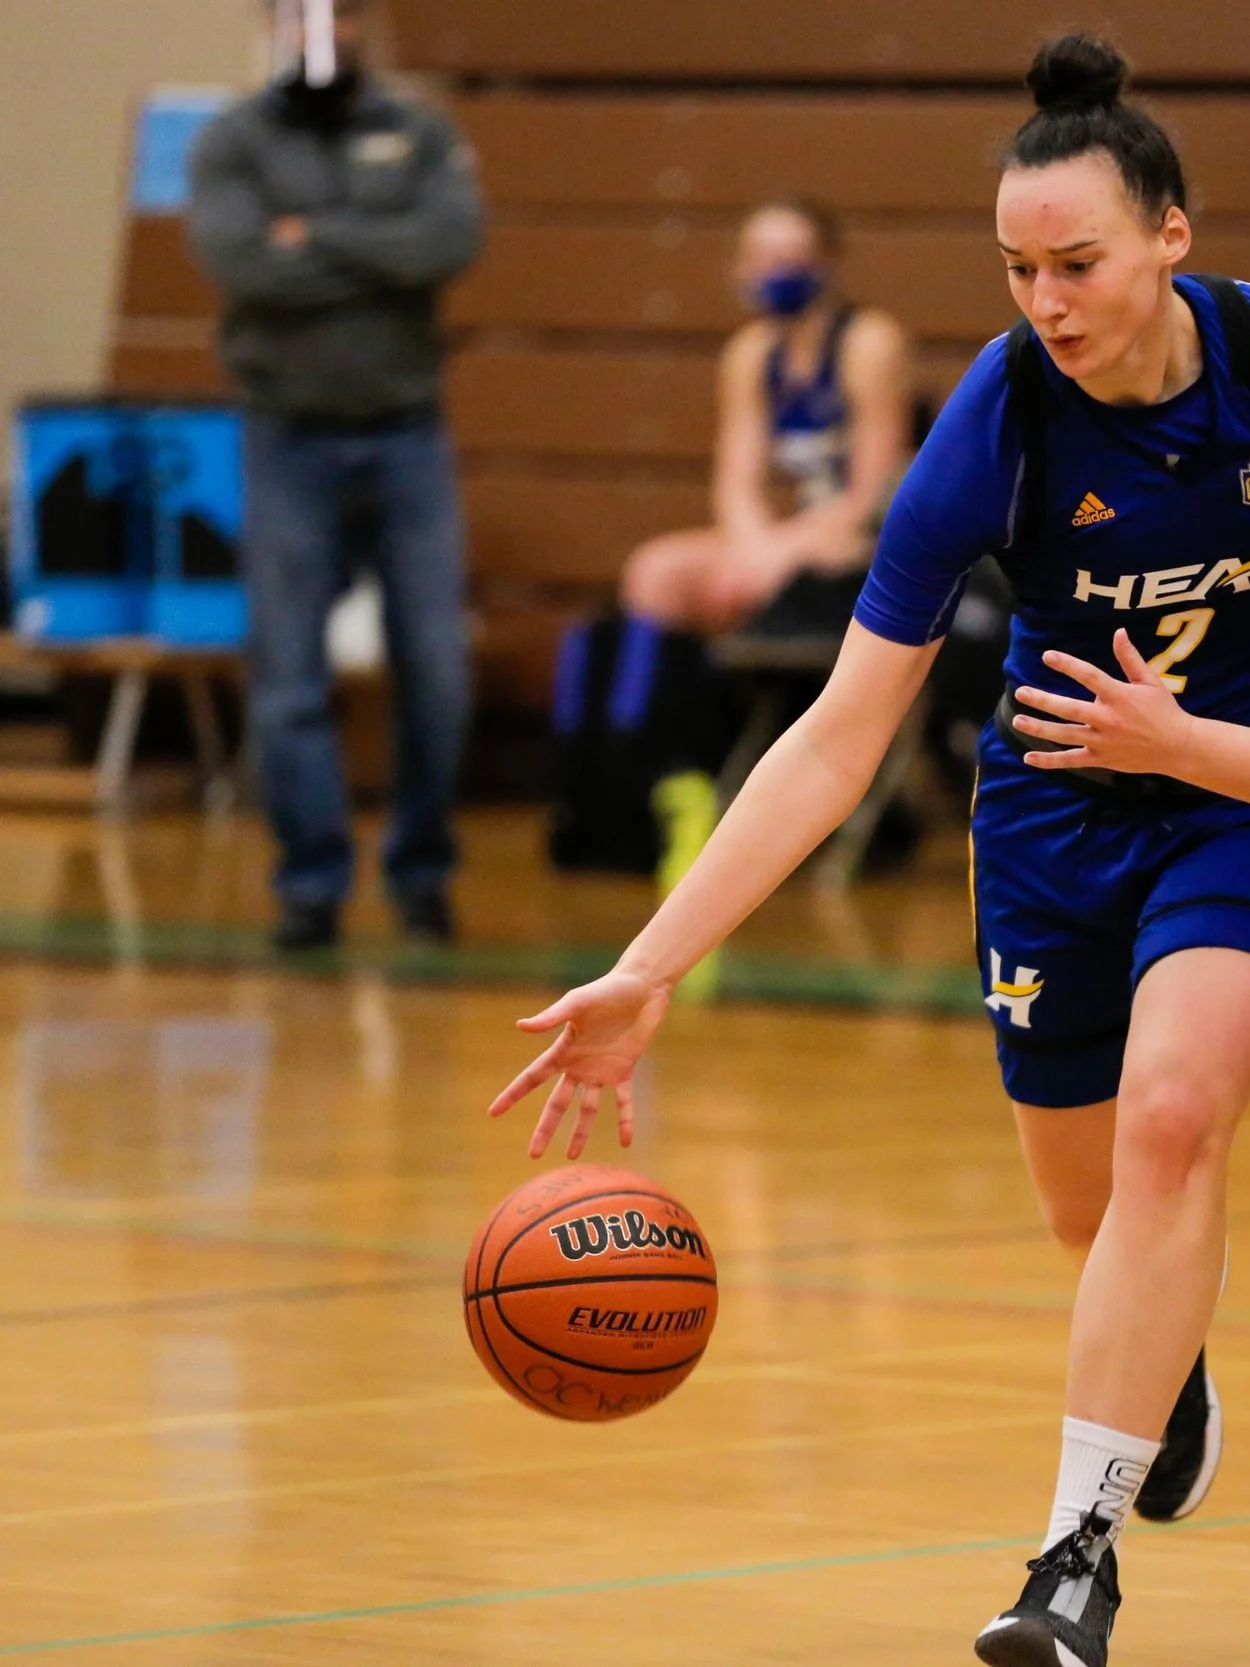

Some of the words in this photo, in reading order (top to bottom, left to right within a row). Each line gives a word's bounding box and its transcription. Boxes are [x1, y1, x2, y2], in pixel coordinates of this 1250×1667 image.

[1072, 508, 1116, 527] adidas
[1147, 607, 1216, 694] 2
[550, 1209, 709, 1262] Wilson
[567, 1305, 708, 1334] EVOLUTION
